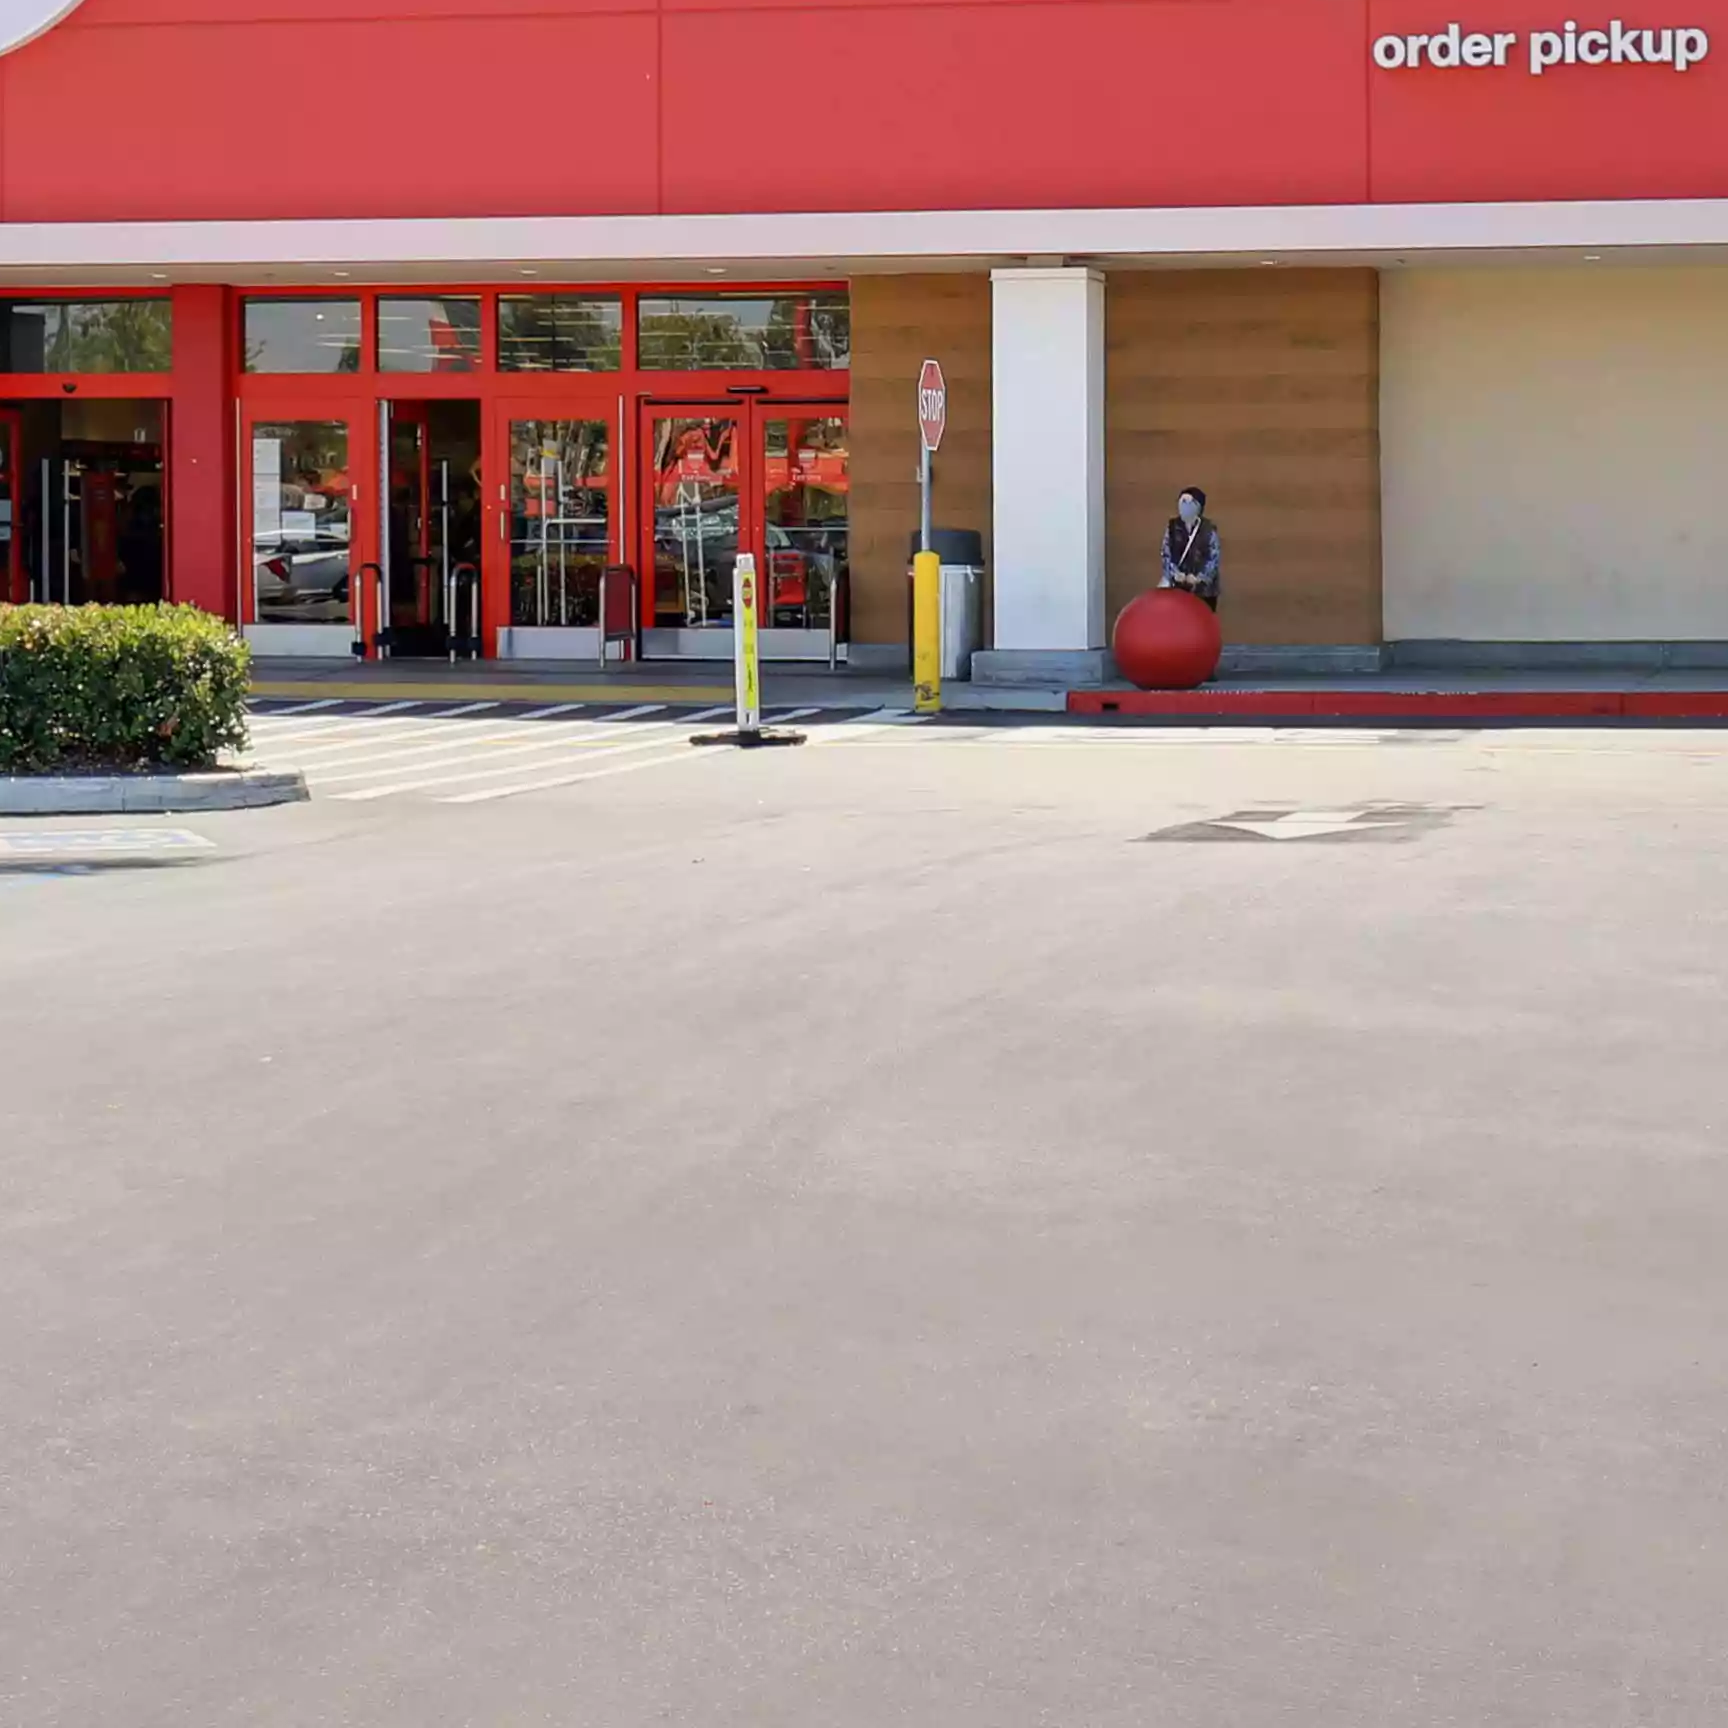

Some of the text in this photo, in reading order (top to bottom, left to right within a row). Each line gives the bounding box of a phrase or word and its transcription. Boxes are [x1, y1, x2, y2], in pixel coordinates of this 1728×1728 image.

[1372, 20, 1709, 74] order pickup
[921, 388, 943, 422] STOP
